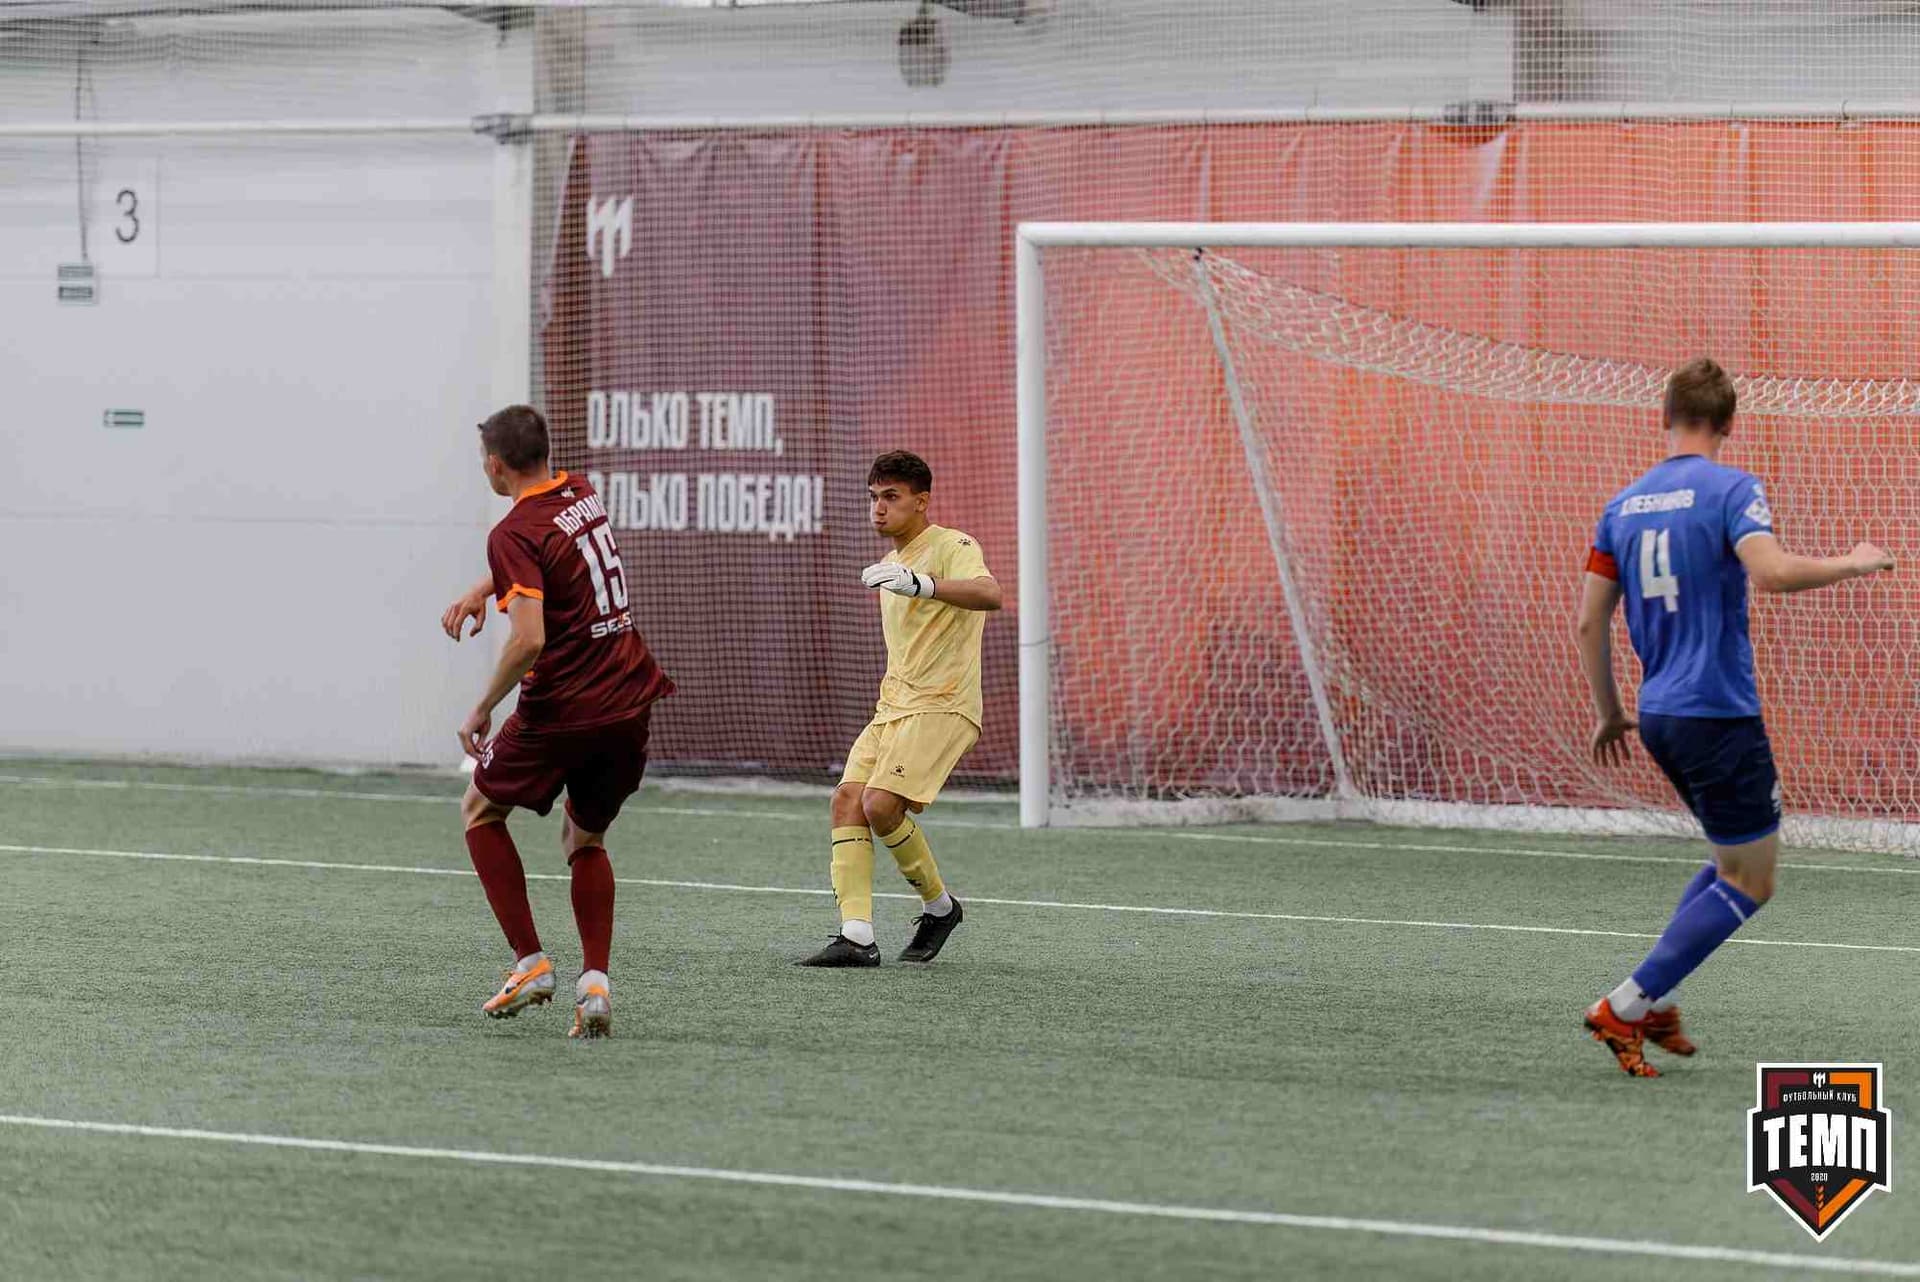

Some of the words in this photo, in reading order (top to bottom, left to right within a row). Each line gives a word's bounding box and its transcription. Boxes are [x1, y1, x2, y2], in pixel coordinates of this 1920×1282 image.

[115, 189, 140, 243] 3
[696, 393, 784, 456] ТЕМП,
[699, 474, 824, 543] ПОБЕДА!
[575, 522, 629, 616] 15
[1640, 528, 1679, 613] 4
